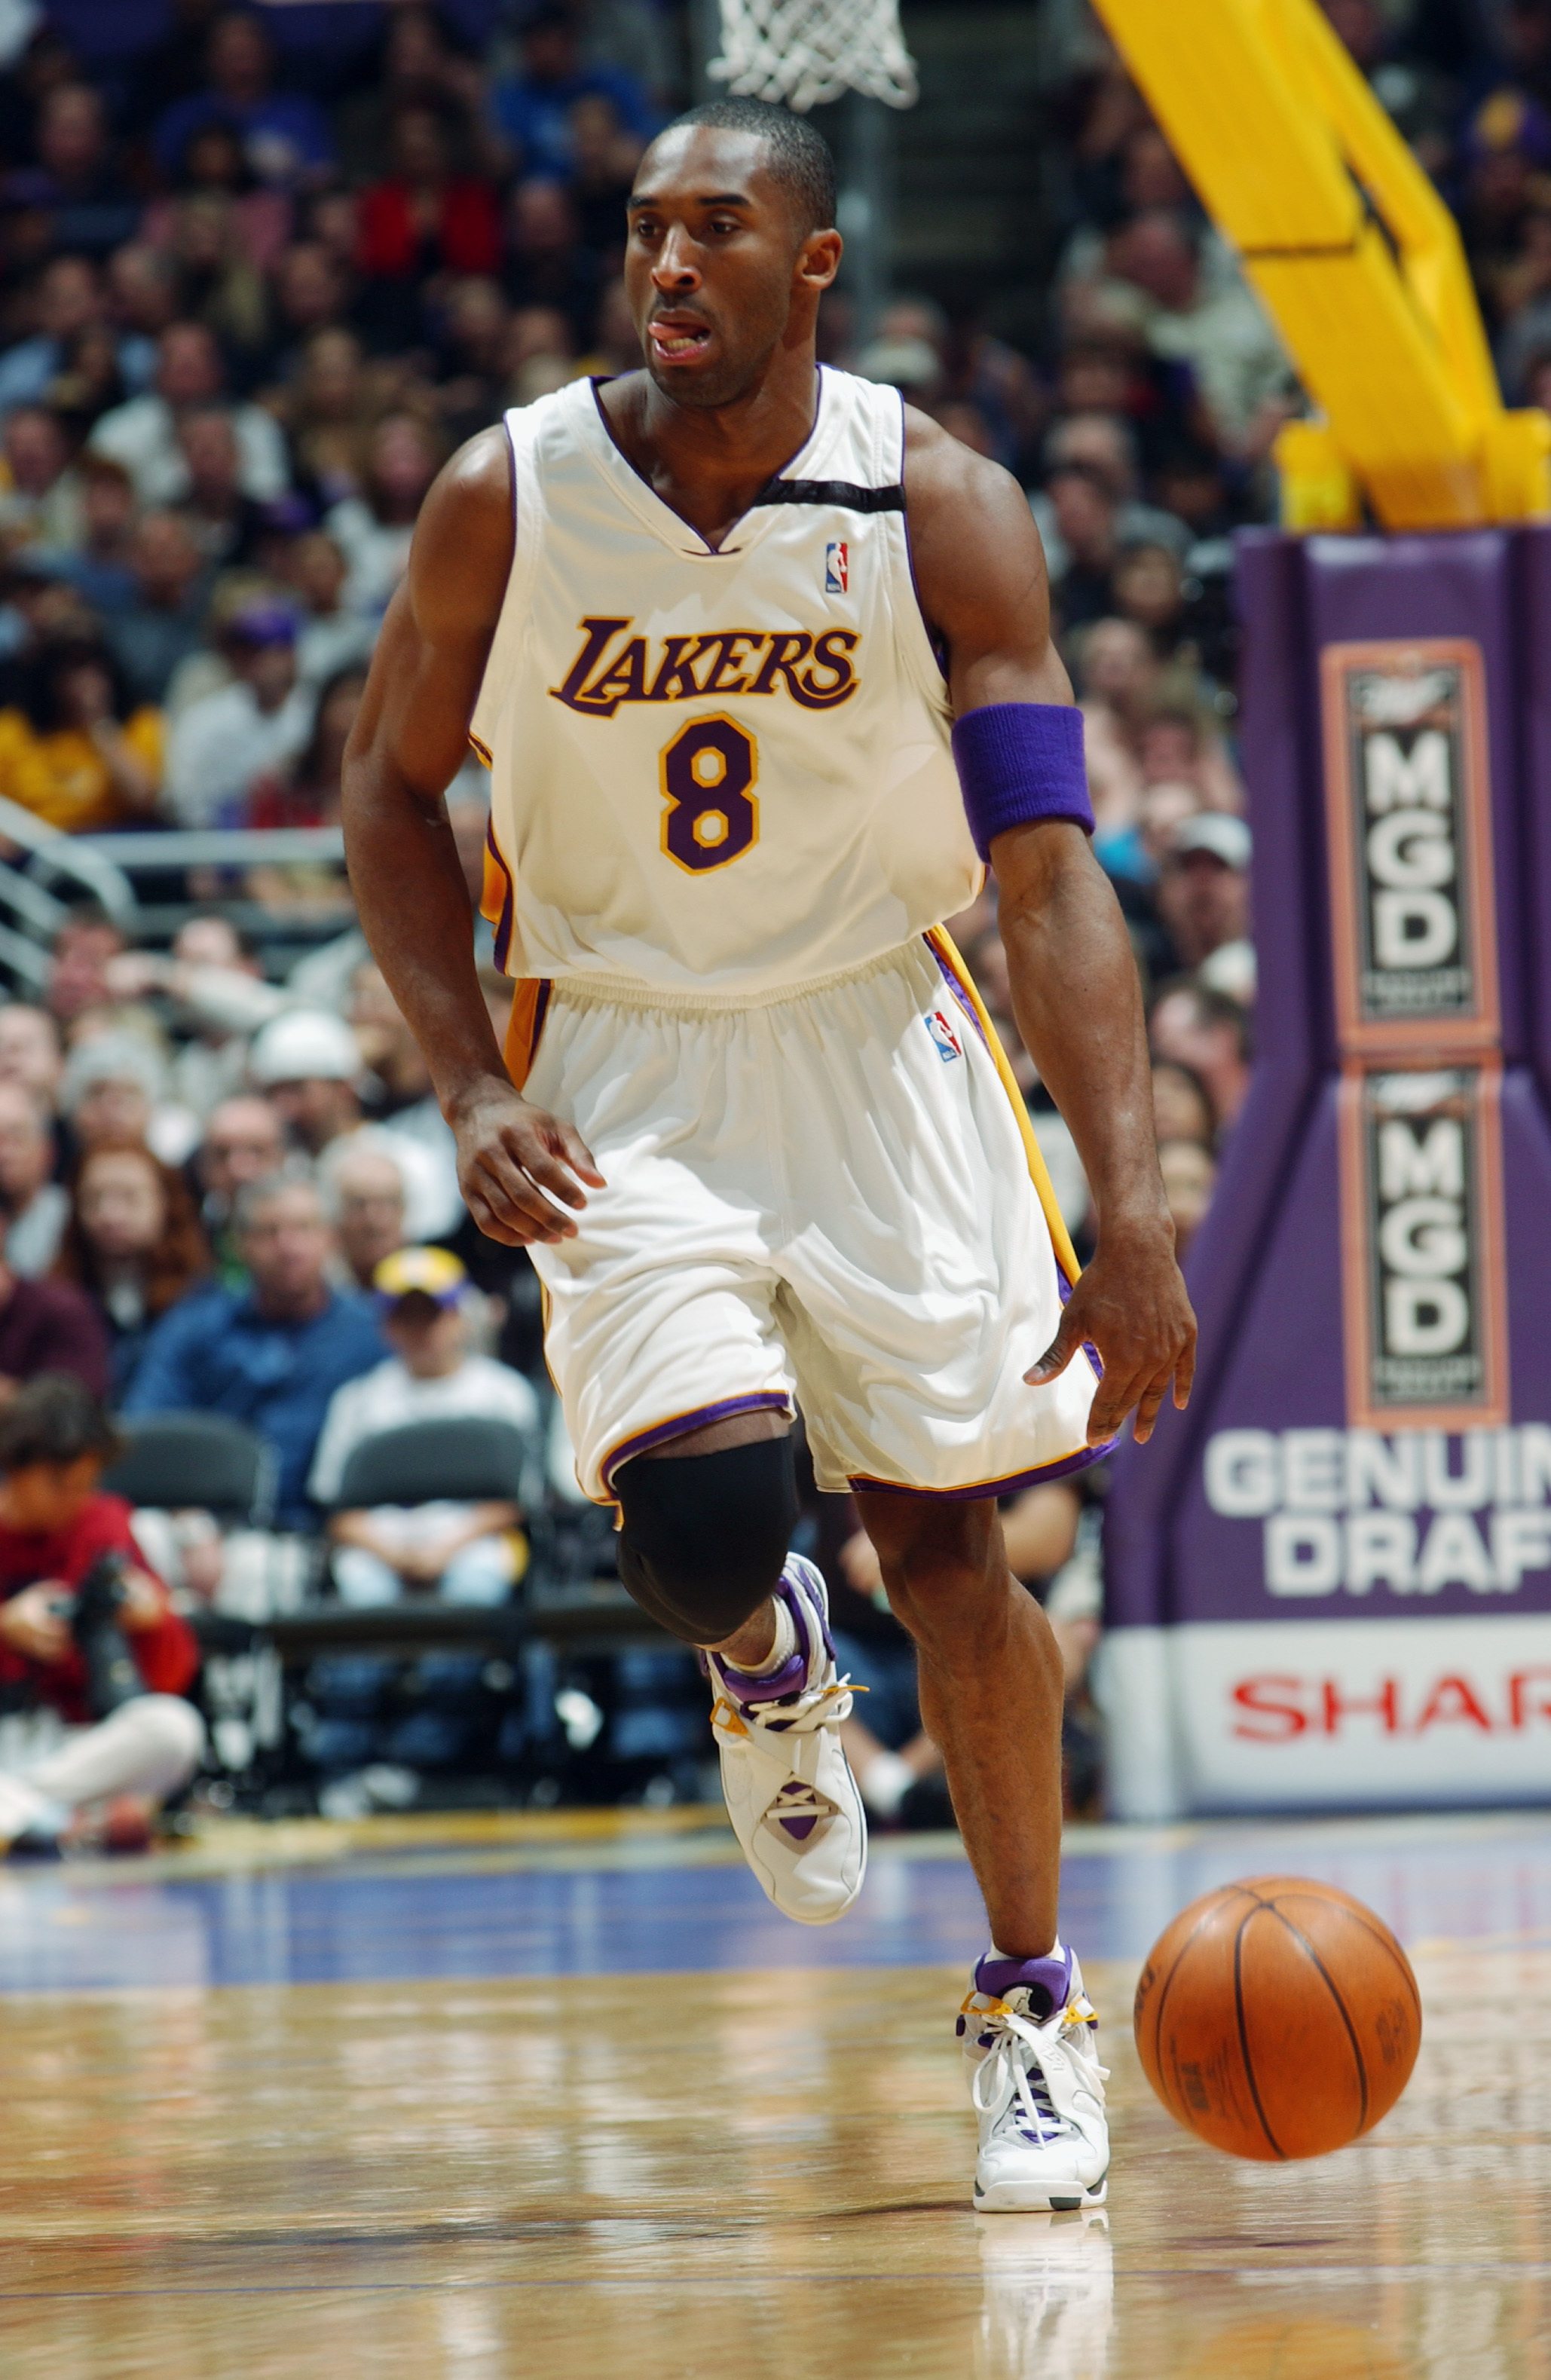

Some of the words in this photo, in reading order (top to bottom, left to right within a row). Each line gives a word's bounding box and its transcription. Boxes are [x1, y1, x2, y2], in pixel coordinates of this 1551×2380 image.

[548, 616, 862, 718] LAKERS
[658, 711, 760, 876] 8
[1365, 730, 1458, 969] MGD
[1378, 1118, 1471, 1357] MGD
[1264, 1513, 1551, 1597] DRAF
